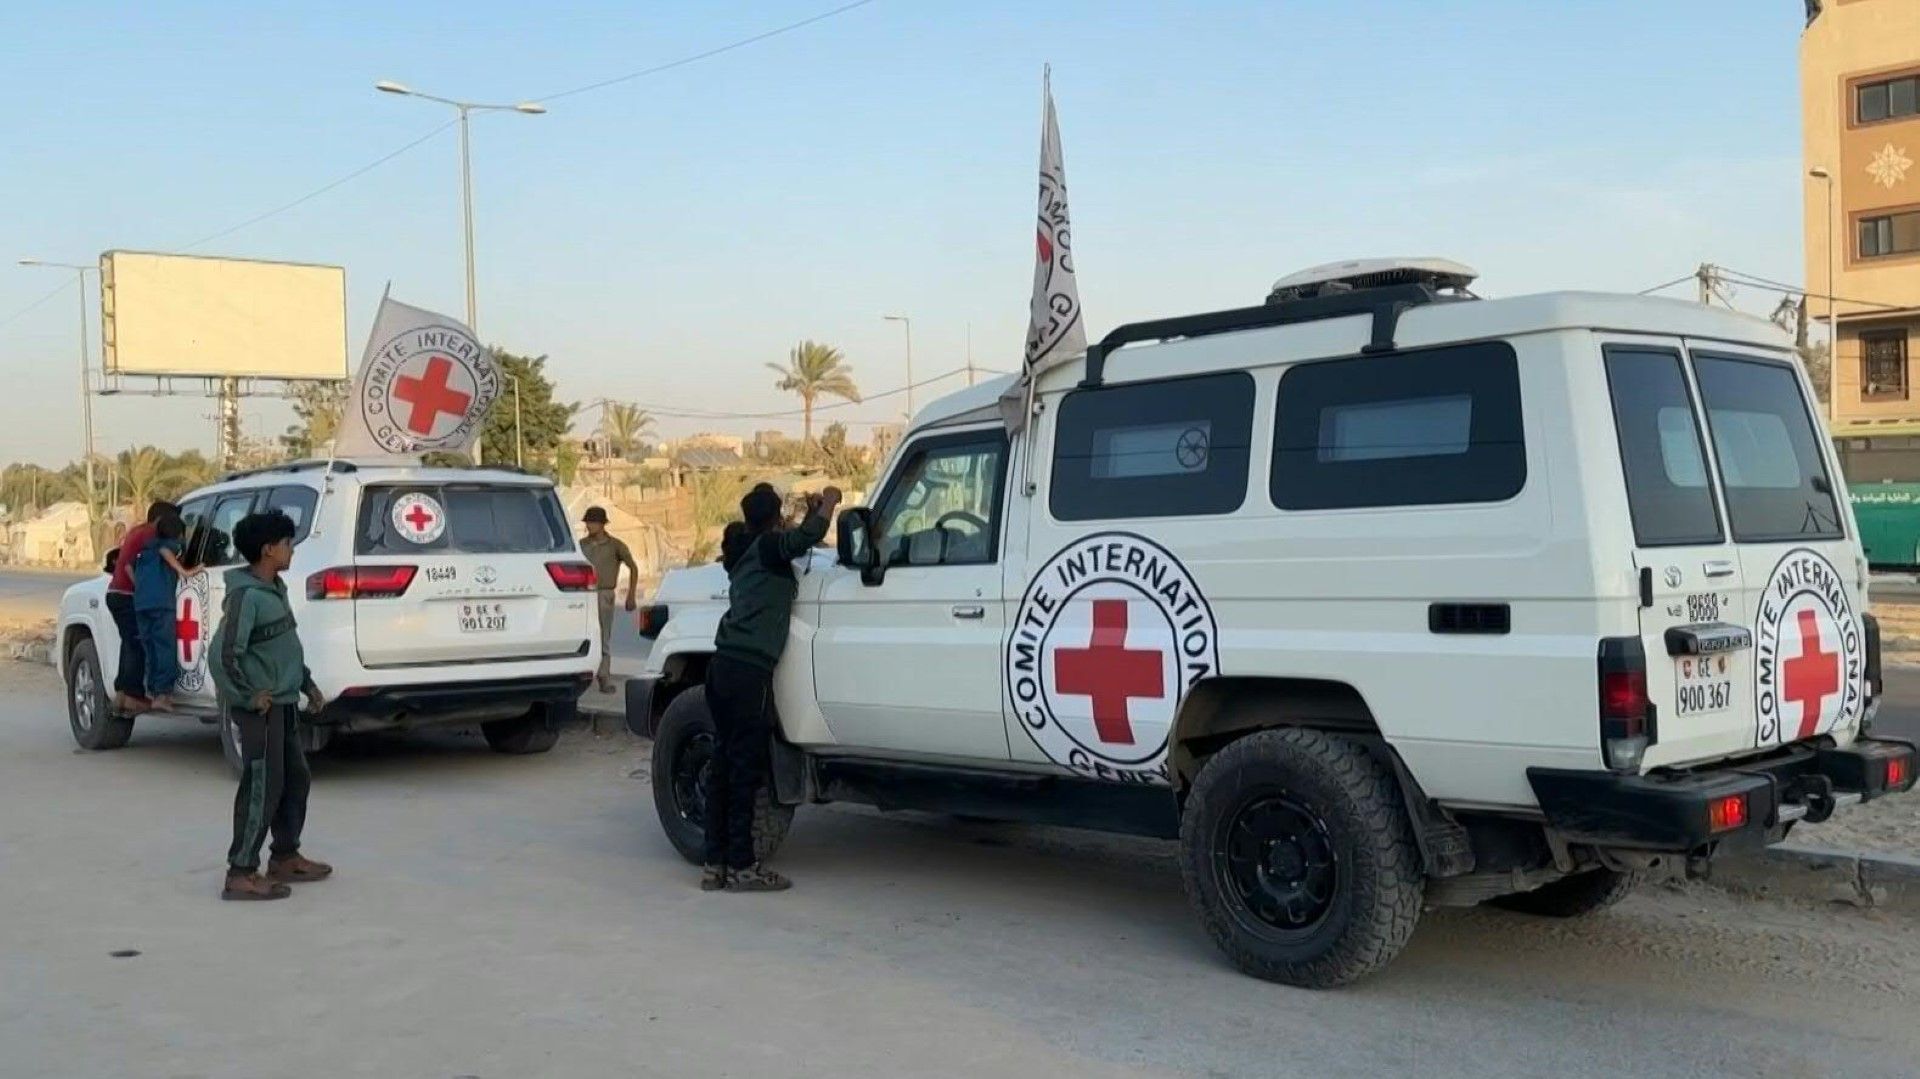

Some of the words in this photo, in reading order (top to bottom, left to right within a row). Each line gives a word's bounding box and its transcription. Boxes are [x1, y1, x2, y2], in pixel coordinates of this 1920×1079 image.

[368, 343, 408, 415] COMITE
[1014, 585, 1056, 730] COMITE
[1056, 543, 1210, 686] INTERNATION
[1698, 657, 1711, 678] GE
[1760, 600, 1778, 742] COMITE
[1679, 684, 1705, 713] 900
[1708, 680, 1731, 709] 367
[1069, 748, 1171, 783] GENEV
